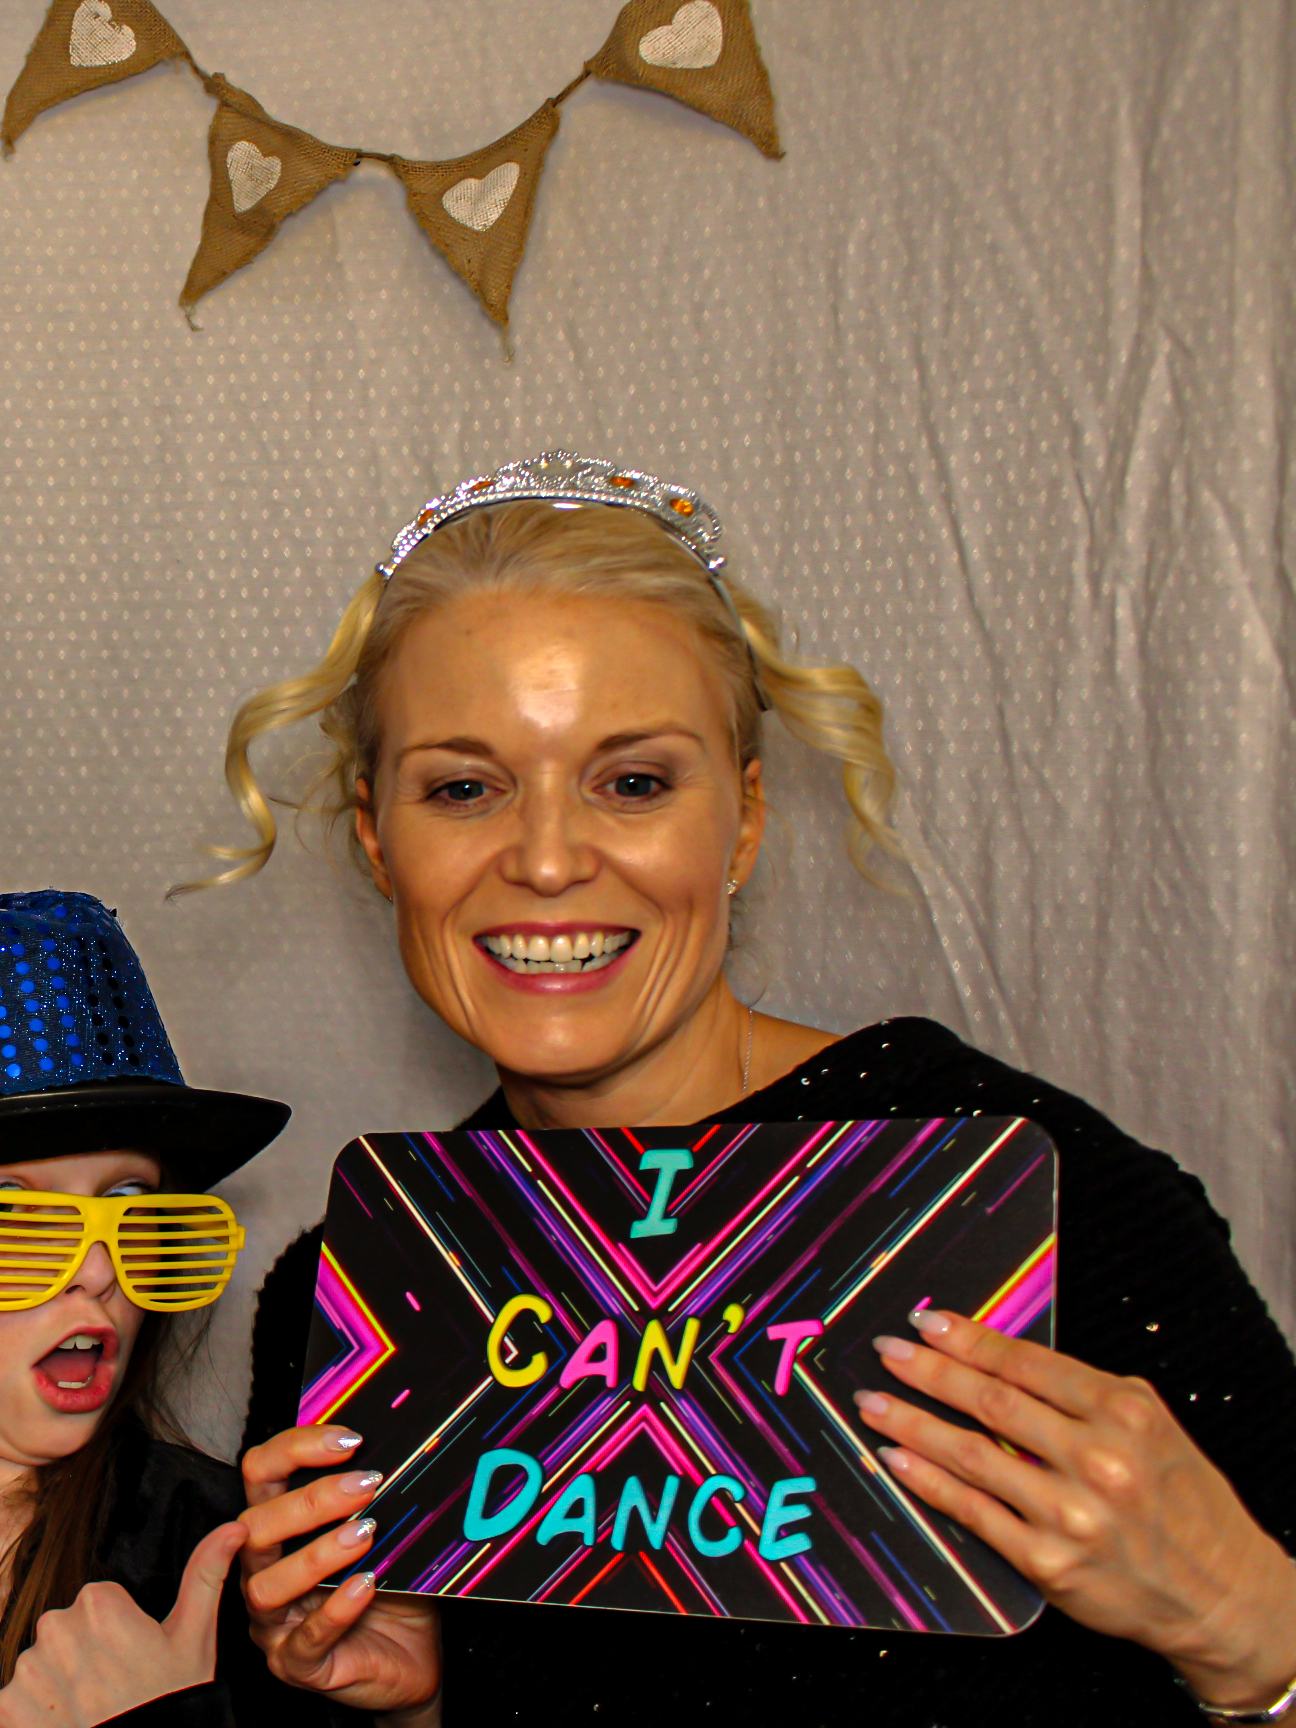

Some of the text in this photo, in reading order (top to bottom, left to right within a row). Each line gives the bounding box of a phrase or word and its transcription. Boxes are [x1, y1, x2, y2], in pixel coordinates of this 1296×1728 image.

[629, 1148, 695, 1239] I
[487, 1294, 825, 1396] CAN'T
[462, 1448, 817, 1562] DANCE
